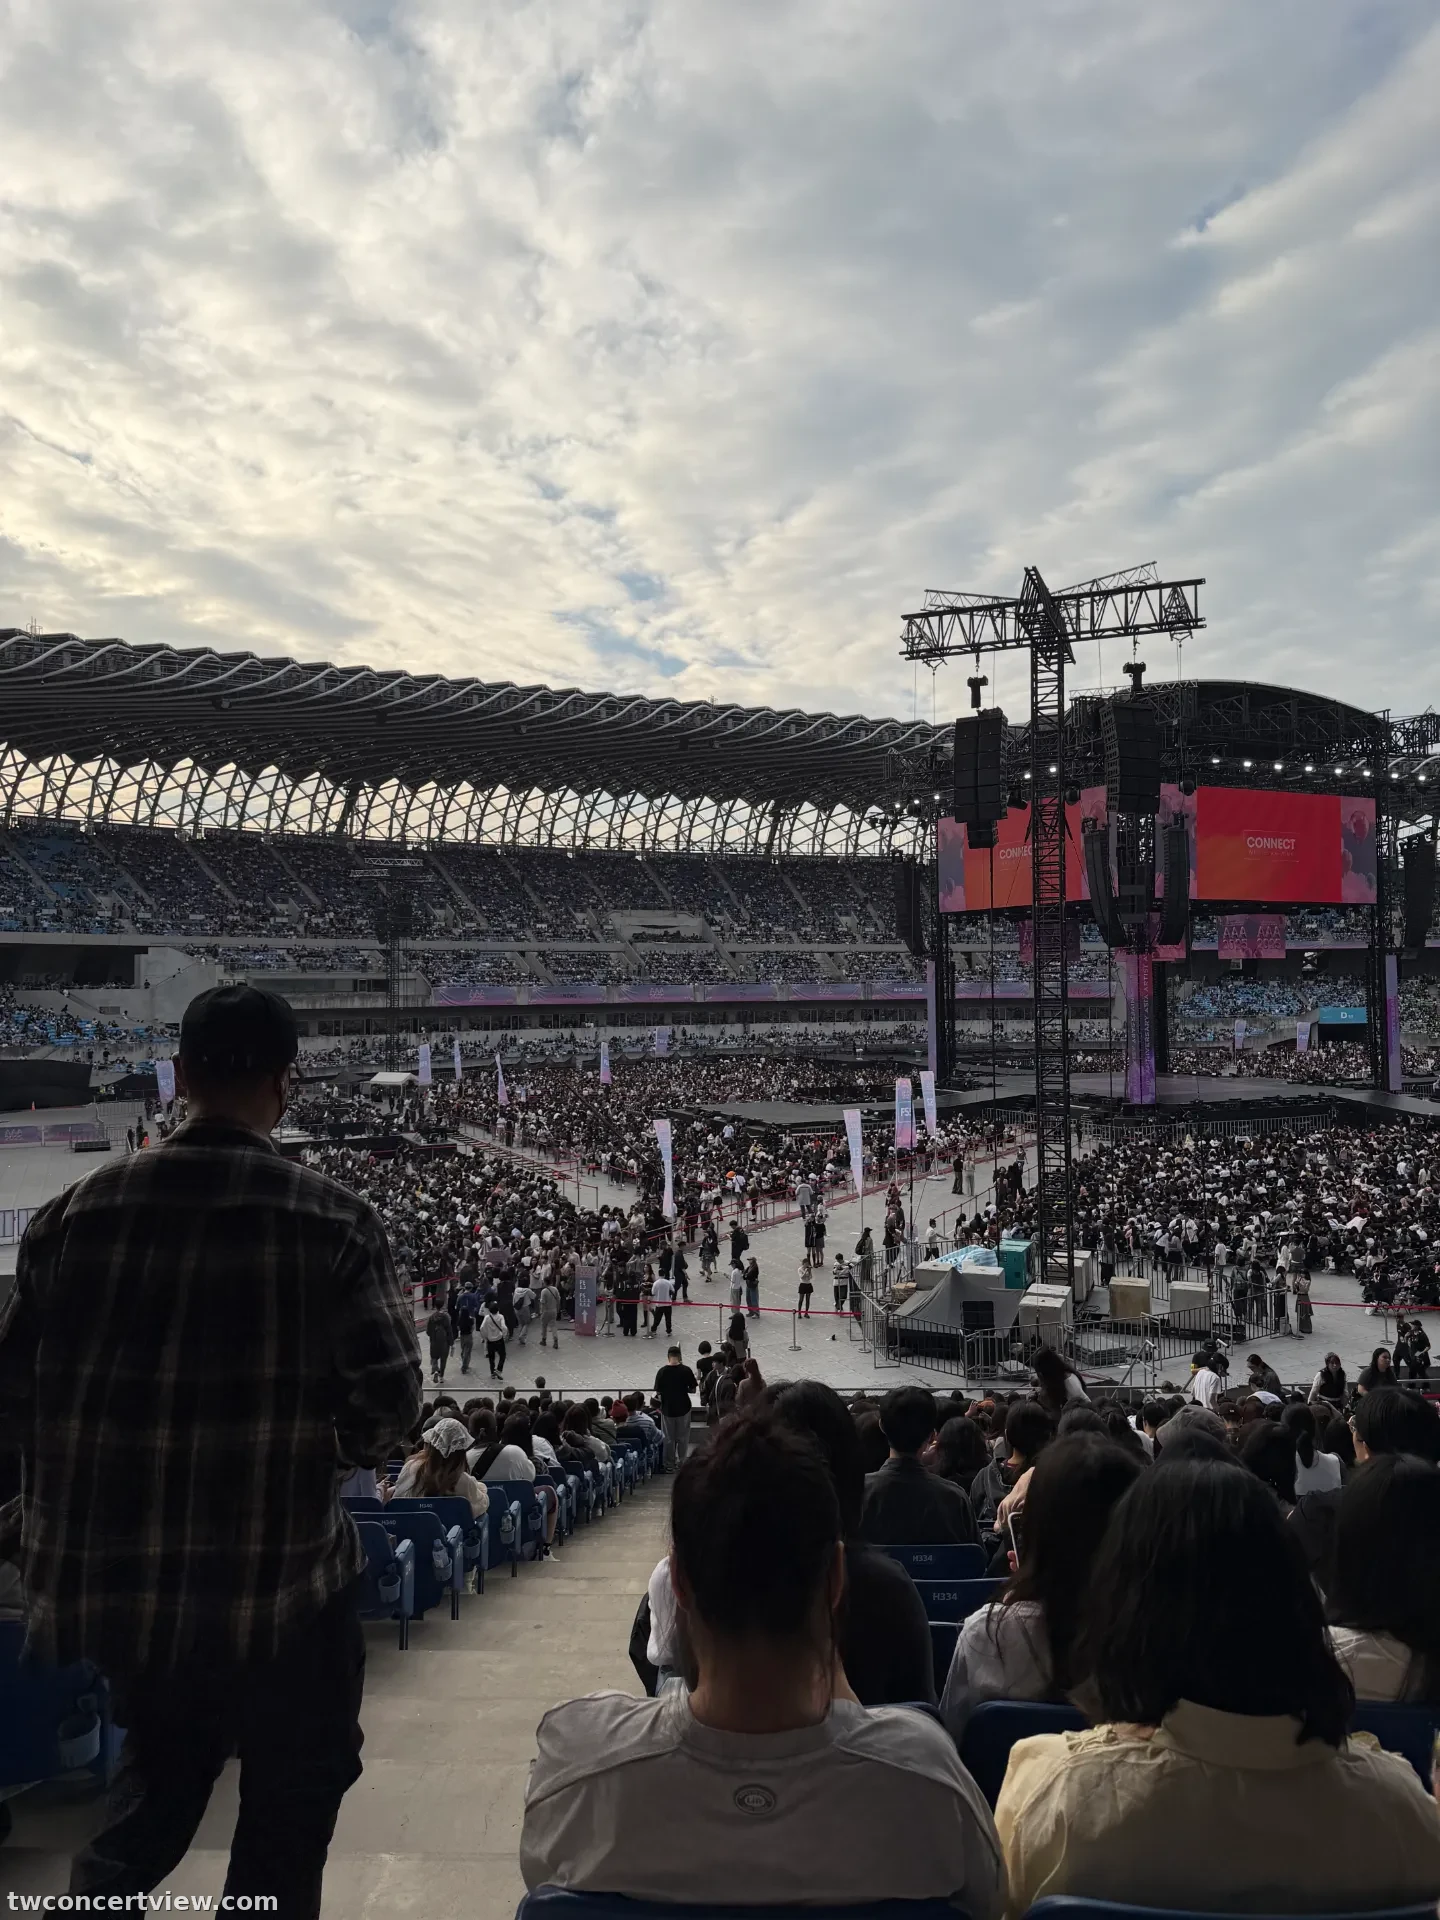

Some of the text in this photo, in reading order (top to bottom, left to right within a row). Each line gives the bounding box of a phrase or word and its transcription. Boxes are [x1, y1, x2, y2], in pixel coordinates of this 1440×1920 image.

[1247, 836, 1296, 850] CONNECT
[999, 845, 1033, 860] CONNEC
[913, 1554, 933, 1562] H334
[932, 1592, 958, 1601] H334
